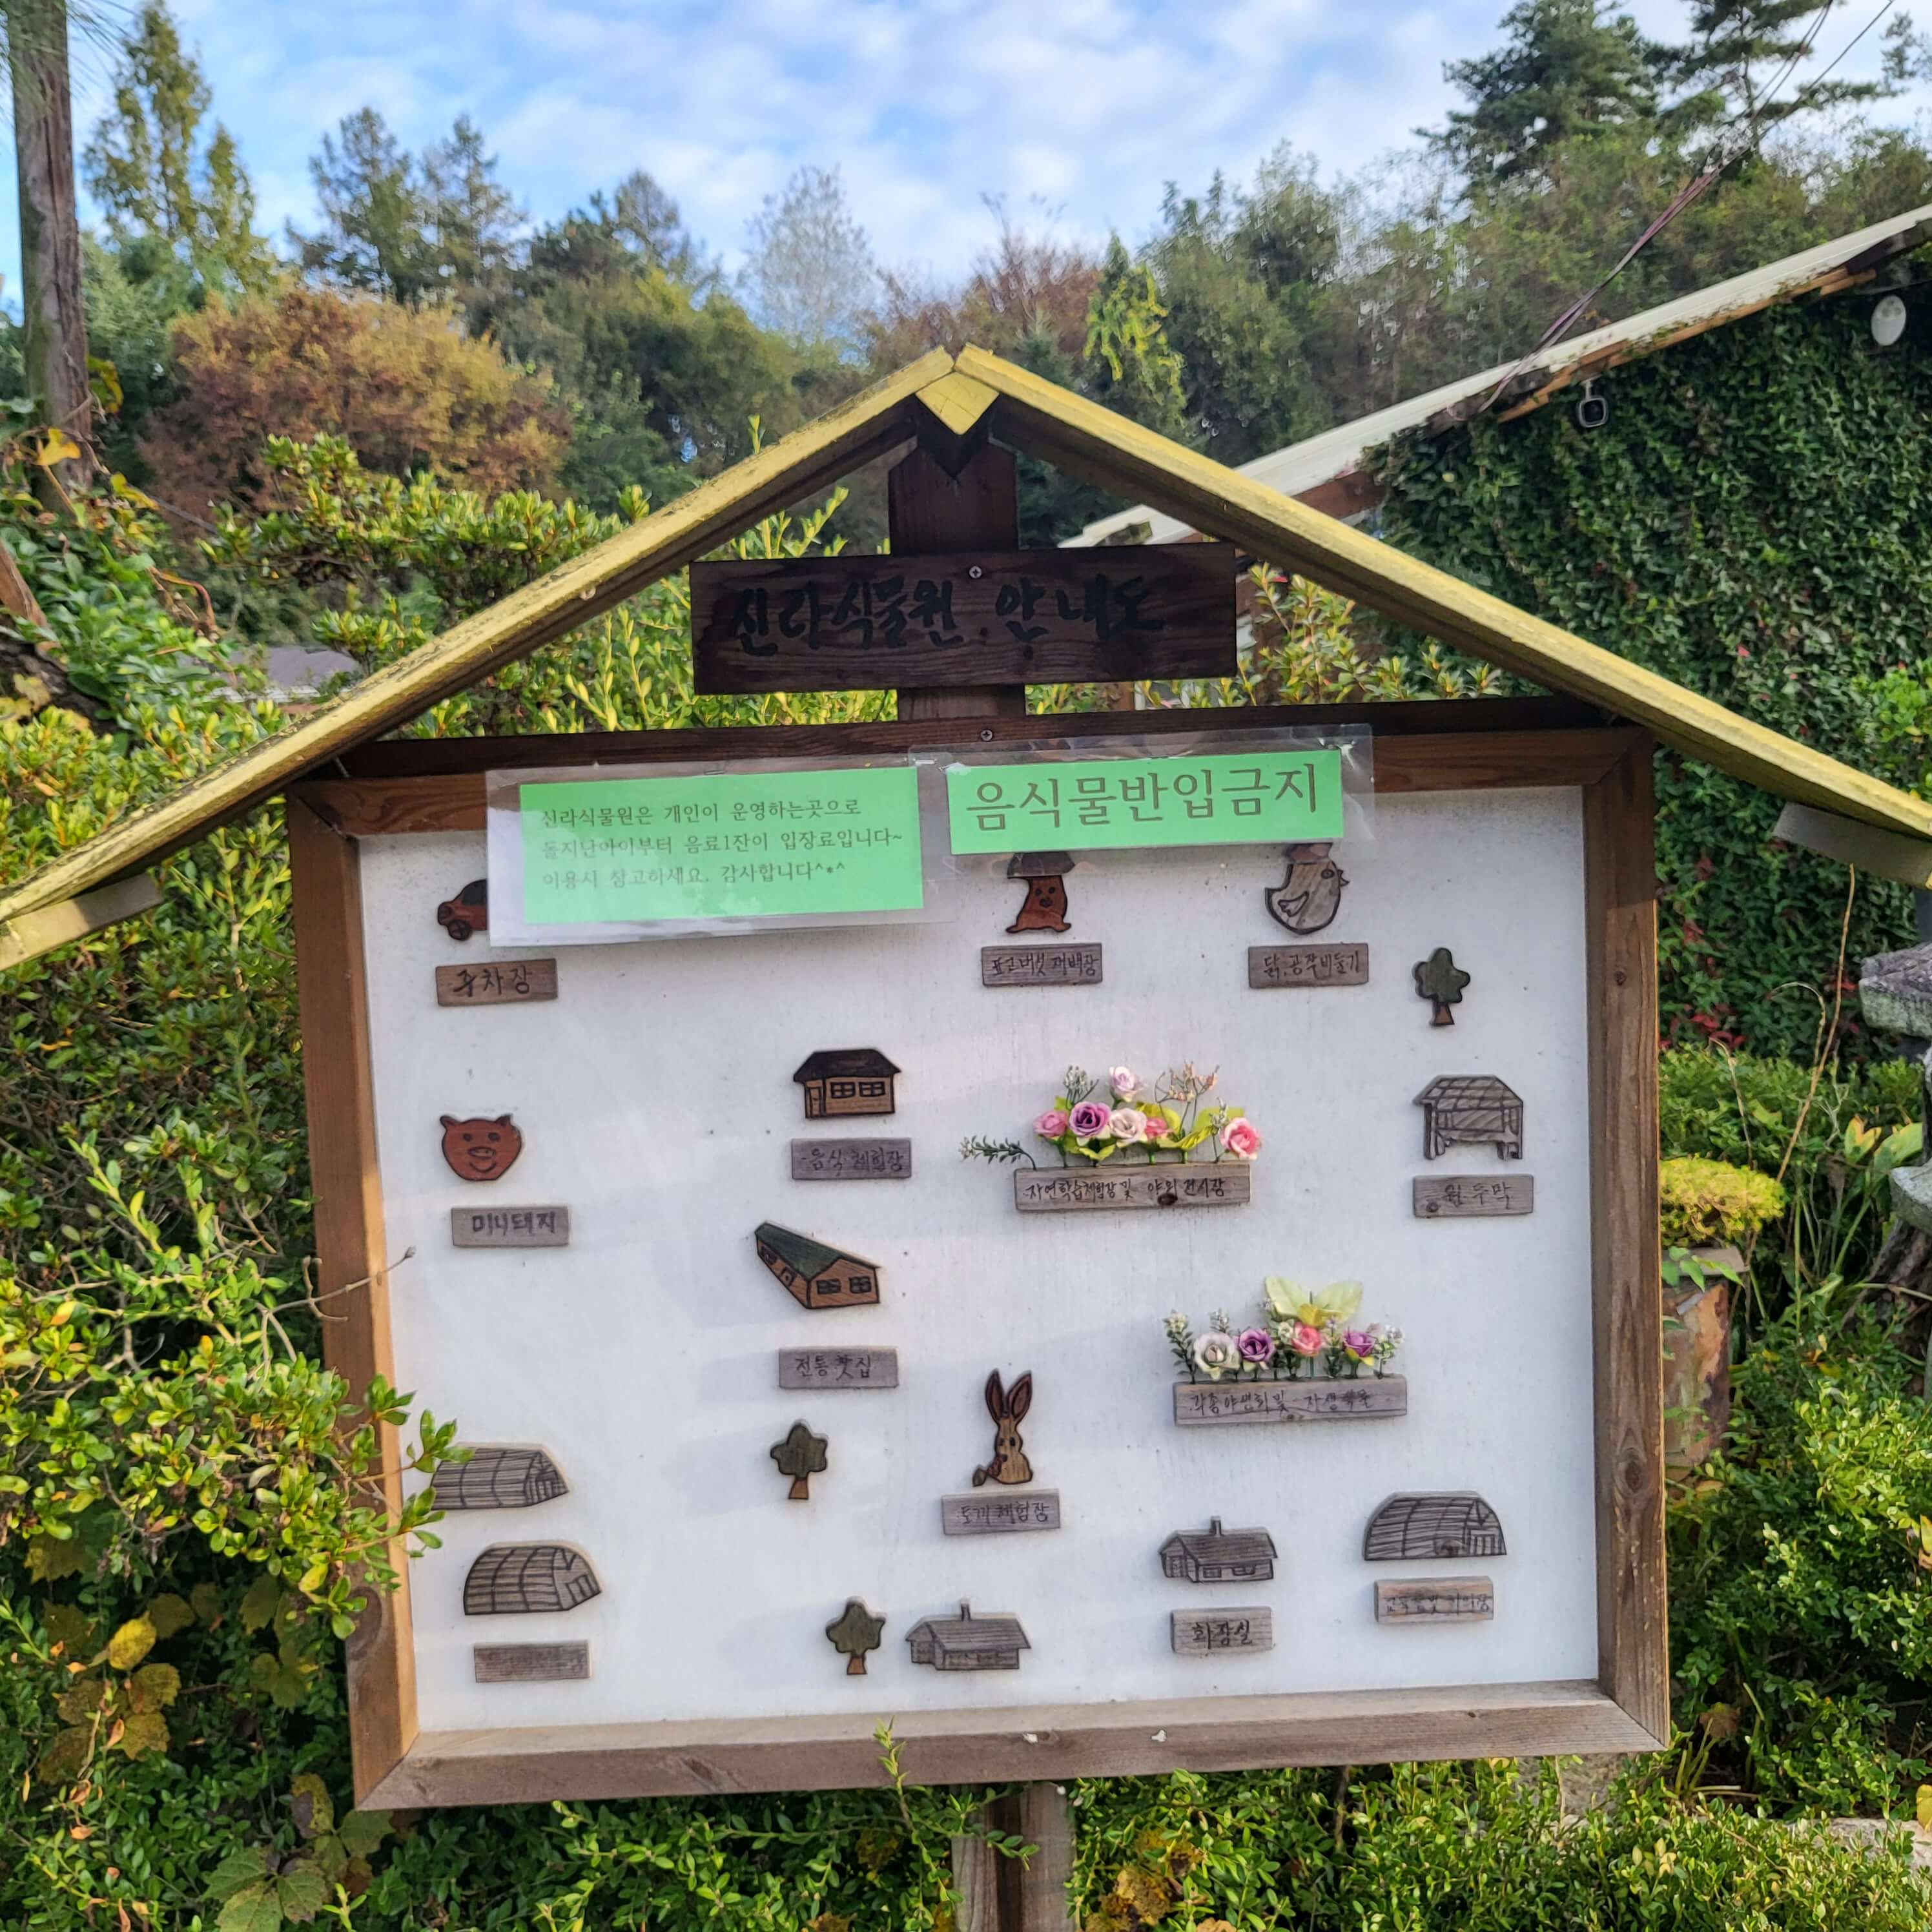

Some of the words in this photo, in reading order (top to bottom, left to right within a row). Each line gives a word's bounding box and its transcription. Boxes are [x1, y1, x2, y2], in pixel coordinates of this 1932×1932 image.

[729, 575, 962, 656] 신라식물원
[542, 807, 653, 828] 신라식물원은
[664, 803, 718, 823] 개인이
[730, 799, 861, 821] 운영하는곳으로
[966, 763, 1317, 832] 음식물반입금지
[542, 836, 672, 859] 돌지난아이부터
[684, 832, 768, 854] 음료1잔이
[781, 827, 903, 850] 입장료입니다~
[543, 869, 598, 890] 이용시
[453, 965, 533, 998] 주차장
[1191, 1618, 1253, 1650] 화장실
